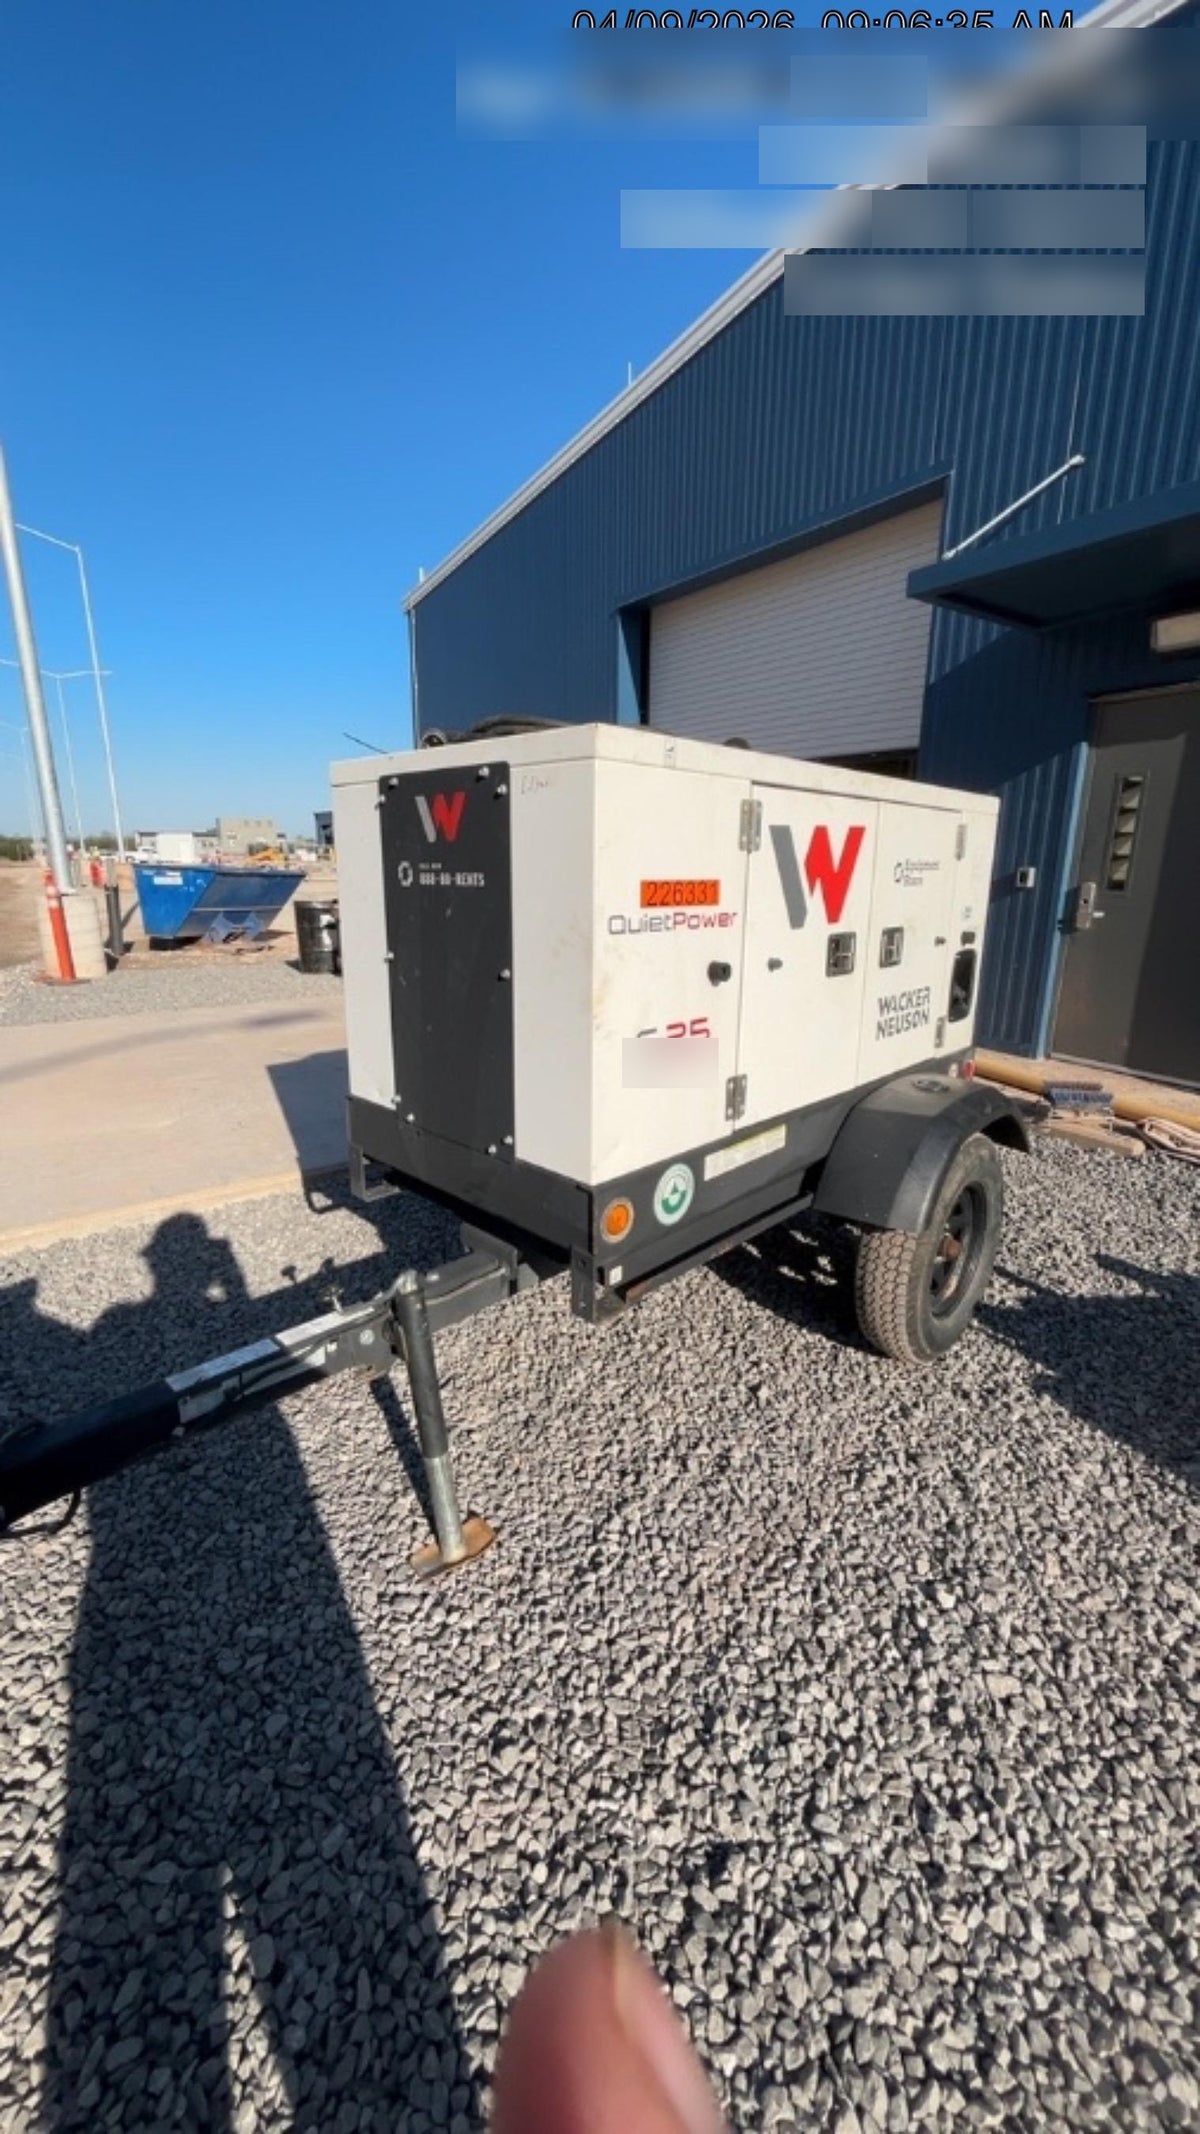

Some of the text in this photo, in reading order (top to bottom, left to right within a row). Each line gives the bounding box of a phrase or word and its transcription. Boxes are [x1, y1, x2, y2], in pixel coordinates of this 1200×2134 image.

[646, 881, 718, 906] 226331
[608, 911, 738, 935] QuietPower
[878, 986, 930, 1017] WACKER
[875, 1007, 930, 1042] NEUSON
